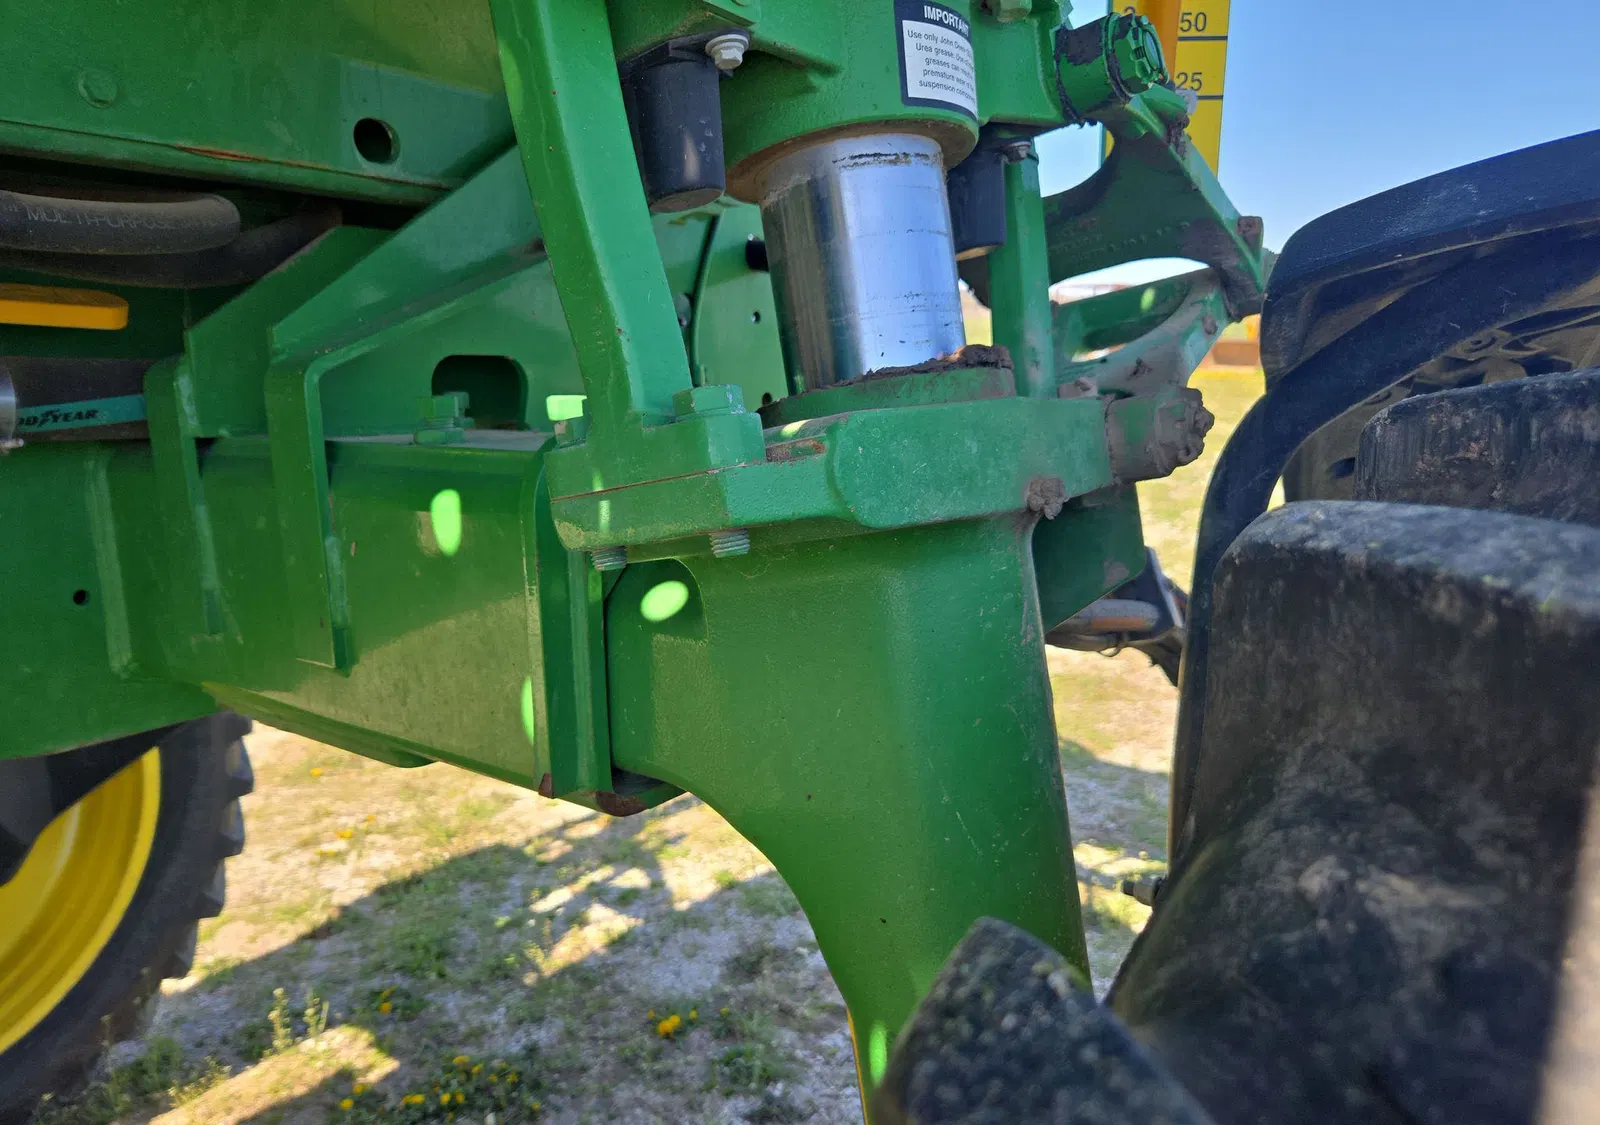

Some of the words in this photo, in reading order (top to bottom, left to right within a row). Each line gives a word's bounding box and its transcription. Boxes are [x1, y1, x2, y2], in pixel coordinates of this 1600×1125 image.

[1180, 12, 1207, 32] 50
[907, 29, 922, 40] Use
[924, 33, 938, 44] only
[916, 43, 933, 53] Urea
[925, 57, 950, 69] greases
[919, 79, 955, 93] suspension
[1175, 72, 1202, 91] 25
